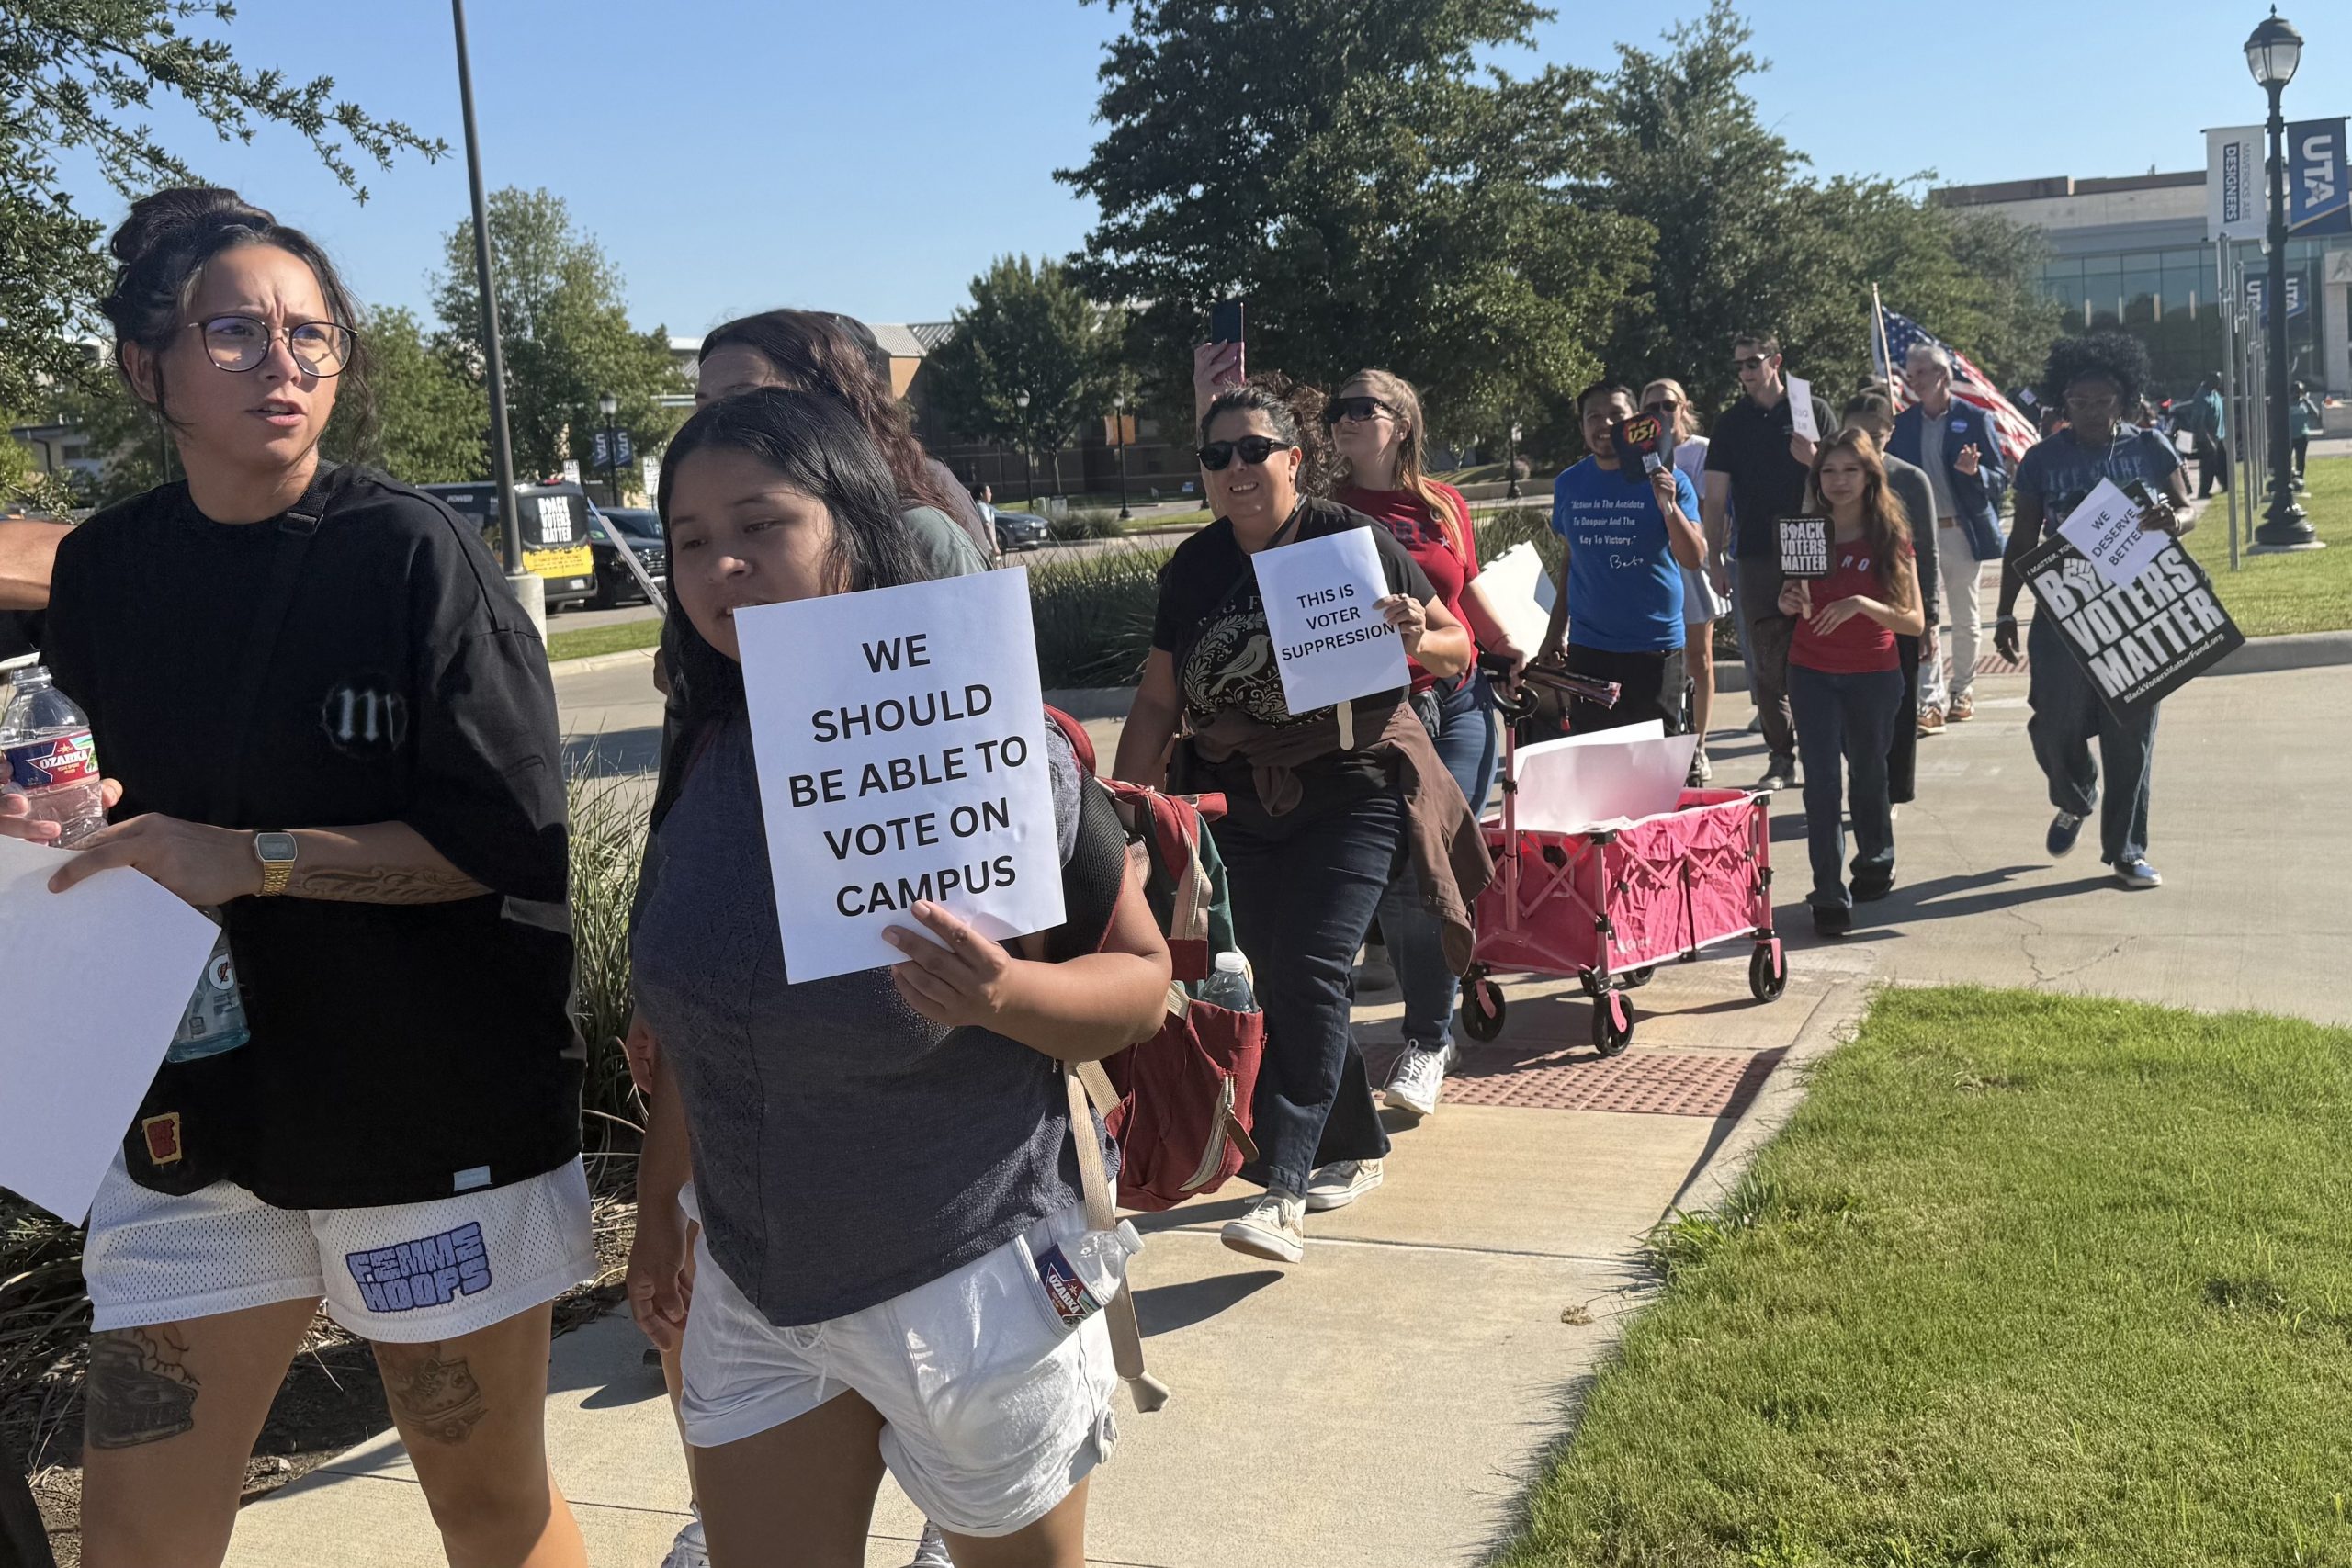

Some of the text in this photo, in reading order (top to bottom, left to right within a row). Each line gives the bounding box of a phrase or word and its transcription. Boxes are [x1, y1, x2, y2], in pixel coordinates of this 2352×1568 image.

[2225, 146, 2238, 220] DESIGNERS
[2302, 135, 2335, 209] UTA
[539, 513, 571, 527] VOTERS
[1573, 517, 1635, 526] To Despair And The
[1602, 500, 1614, 508] The
[2091, 510, 2111, 531] WE
[542, 526, 572, 543] MATTER
[1580, 535, 1591, 546] Key
[1594, 535, 1603, 544] To
[1781, 538, 1827, 556] VOTERS
[2091, 508, 2137, 558] DESERVE
[1781, 555, 1827, 571] MATTER
[1297, 583, 1354, 609] THIS IS
[2061, 547, 2198, 657] VOTERS
[1306, 606, 1361, 630] VOTER
[862, 633, 931, 673] WE
[1282, 622, 1396, 661] SUPPRESSION
[2087, 587, 2226, 699] MATTER
[811, 683, 993, 743] SHOULD
[39, 749, 89, 770] OZARKA
[788, 735, 1028, 808] BE ABLE TO
[823, 796, 1010, 861] VOTE ON
[836, 855, 1016, 918] CAMPUS
[345, 1221, 487, 1284] FEMME
[358, 1255, 492, 1313] HOOPS
[1048, 1274, 1080, 1314] OZARKA
